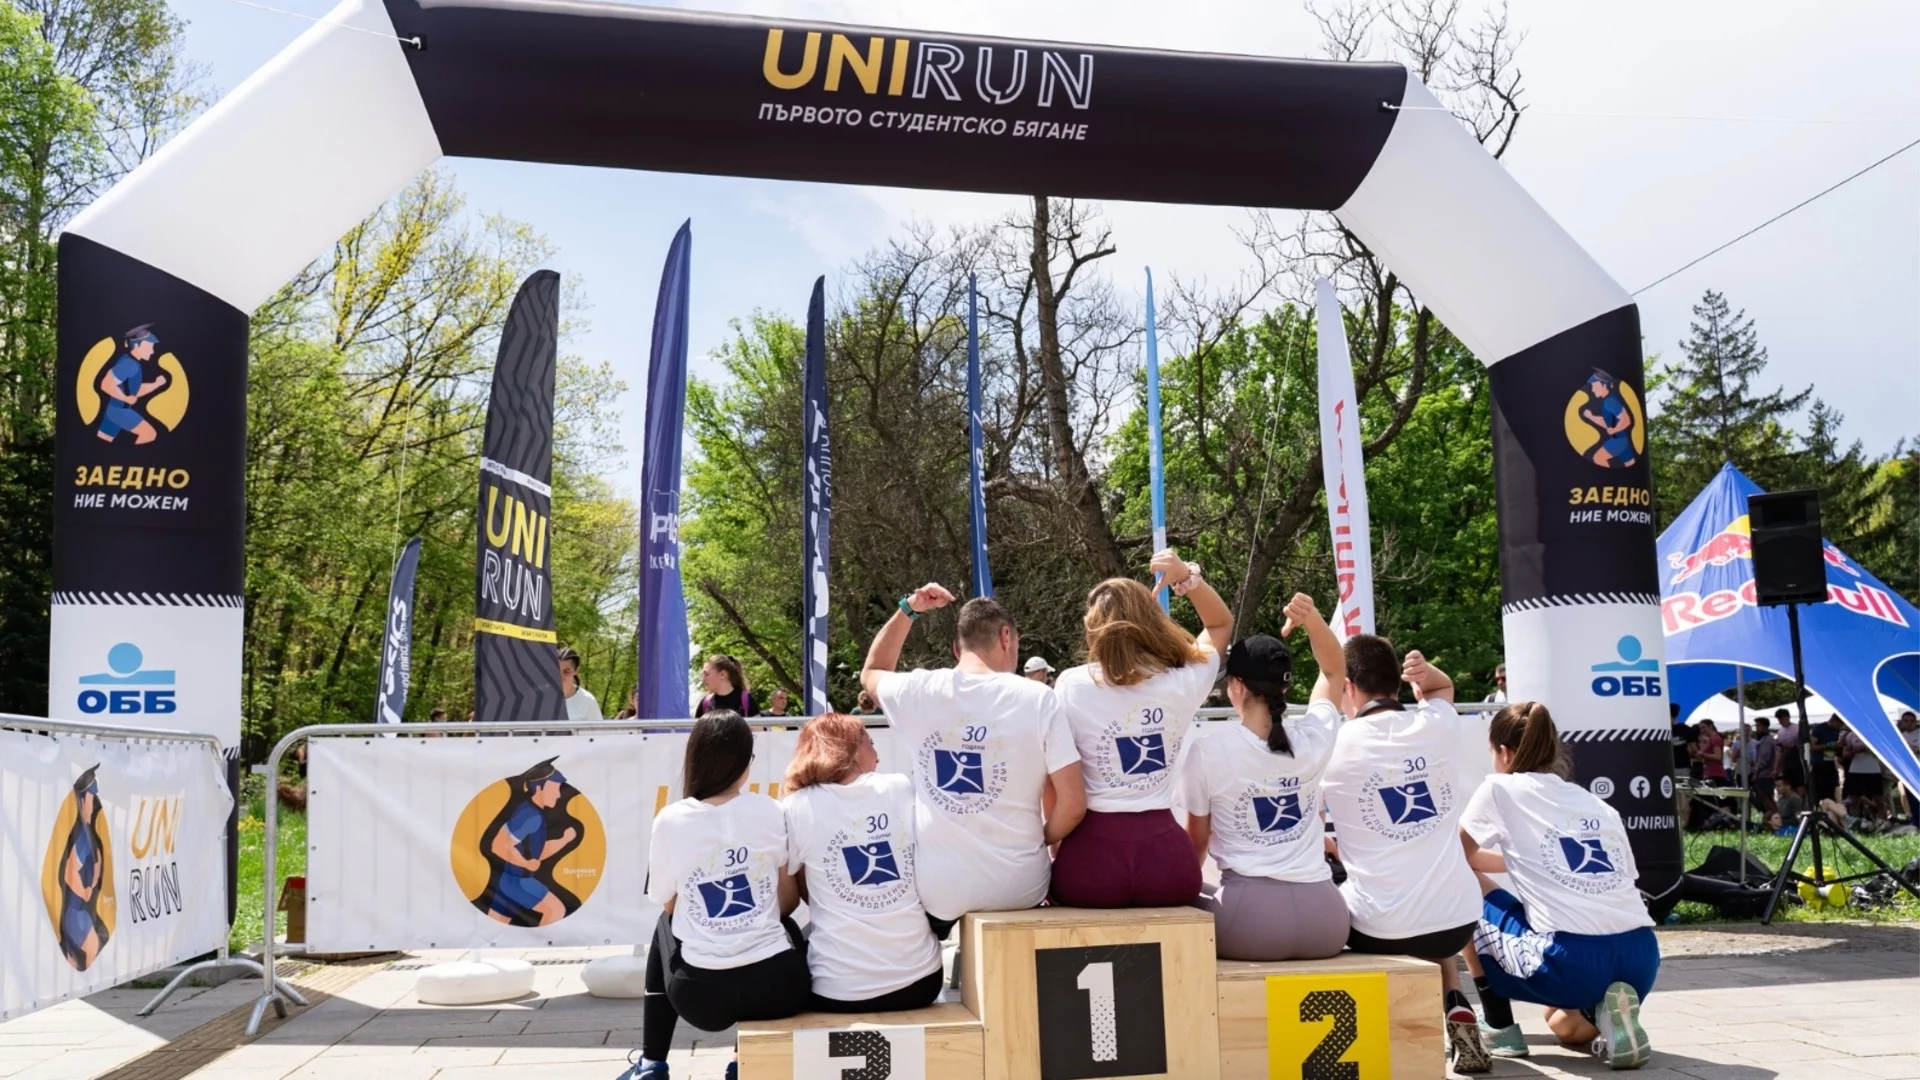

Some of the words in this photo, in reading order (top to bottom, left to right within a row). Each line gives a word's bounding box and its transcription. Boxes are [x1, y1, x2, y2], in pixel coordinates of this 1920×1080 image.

[758, 103, 863, 126] ПЪРВОТО
[869, 111, 1007, 136] СТУДЕНТСКО
[1012, 120, 1088, 141] БЯГАНЕ
[74, 465, 190, 490] ЗАЕДНО
[74, 493, 105, 509] НИЕ
[110, 494, 190, 511] МОЖЕМ
[1568, 486, 1650, 506] ЗАЕДНО
[486, 485, 547, 569] UNI
[1569, 510, 1602, 524] НИЕ
[1606, 509, 1651, 525] МОЖЕМ
[482, 548, 543, 622] RUN
[1827, 583, 1904, 624] ull
[1591, 676, 1662, 697] ОББ
[77, 689, 177, 714] ОББ
[1141, 707, 1163, 726] 30
[962, 725, 987, 743] 30
[1403, 756, 1426, 774] 30
[866, 813, 889, 834] 30
[1579, 818, 1600, 830] 30
[724, 846, 748, 868] 30
[129, 861, 182, 923] RUN
[1076, 961, 1117, 1062] 1
[1299, 989, 1360, 1080] 2
